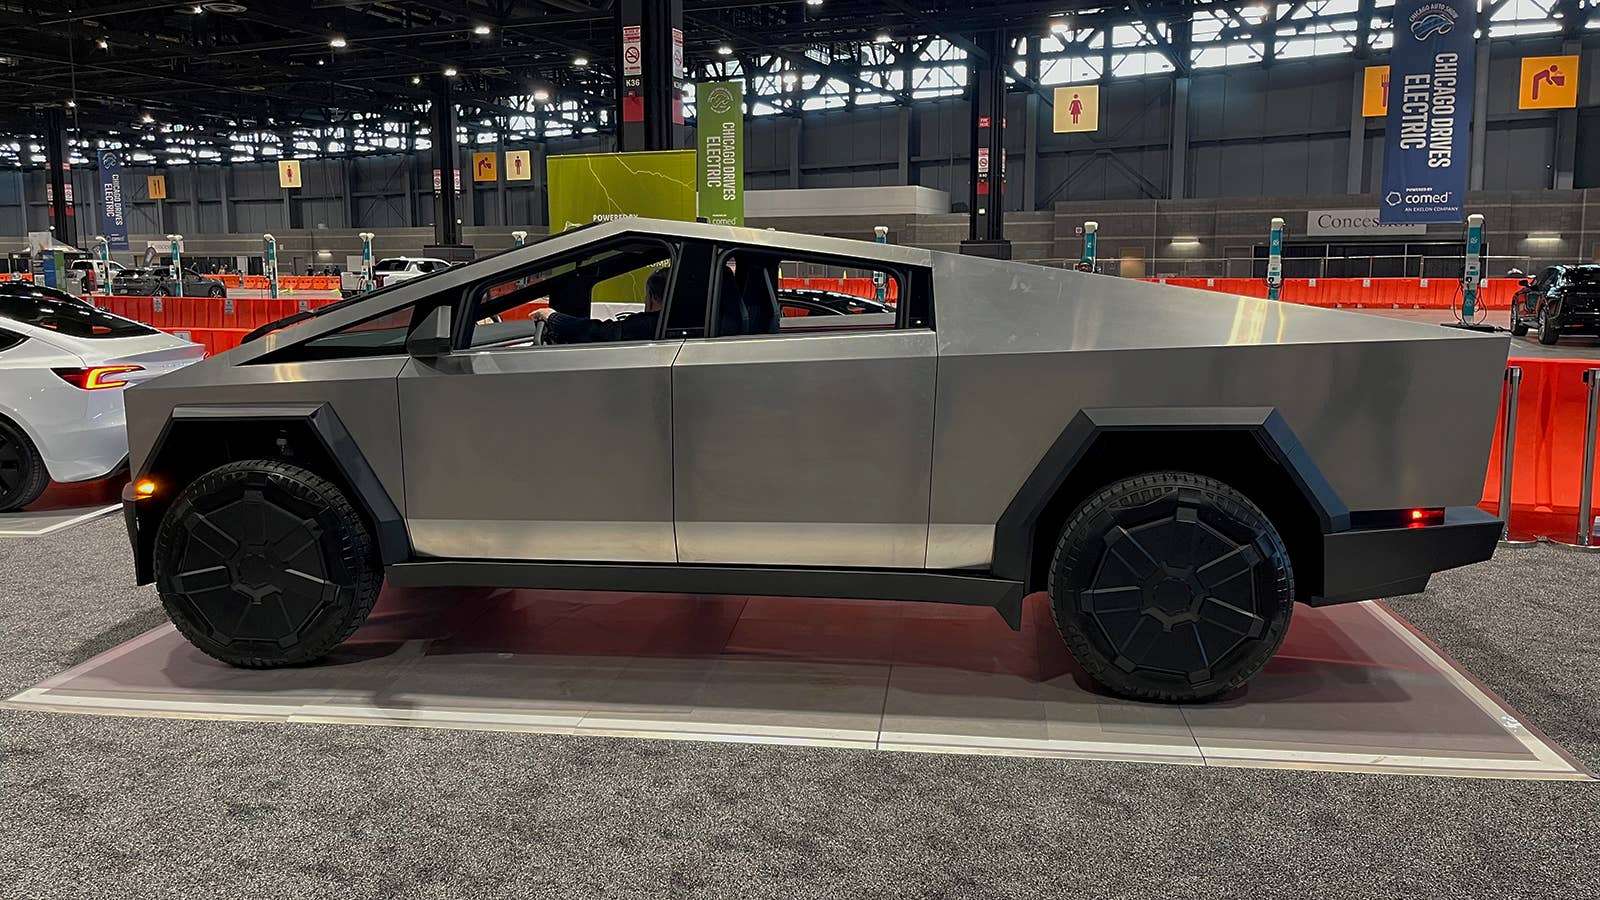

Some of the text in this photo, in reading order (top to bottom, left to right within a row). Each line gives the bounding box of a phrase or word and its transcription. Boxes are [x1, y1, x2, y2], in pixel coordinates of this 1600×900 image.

[1409, 5, 1430, 22] CHICAGO
[625, 79, 640, 87] K36
[1400, 74, 1431, 150] ELECTRIC
[1428, 53, 1458, 168] CHICAGO DRIVES
[706, 136, 721, 188] ELECTRIC
[722, 122, 736, 201] CHICAGO DRIVES
[104, 183, 115, 217] ELECTRIC
[112, 174, 121, 202] CHICAGO
[1405, 191, 1448, 204] comed
[114, 202, 123, 226] DRIVES
[712, 216, 736, 226] comed
